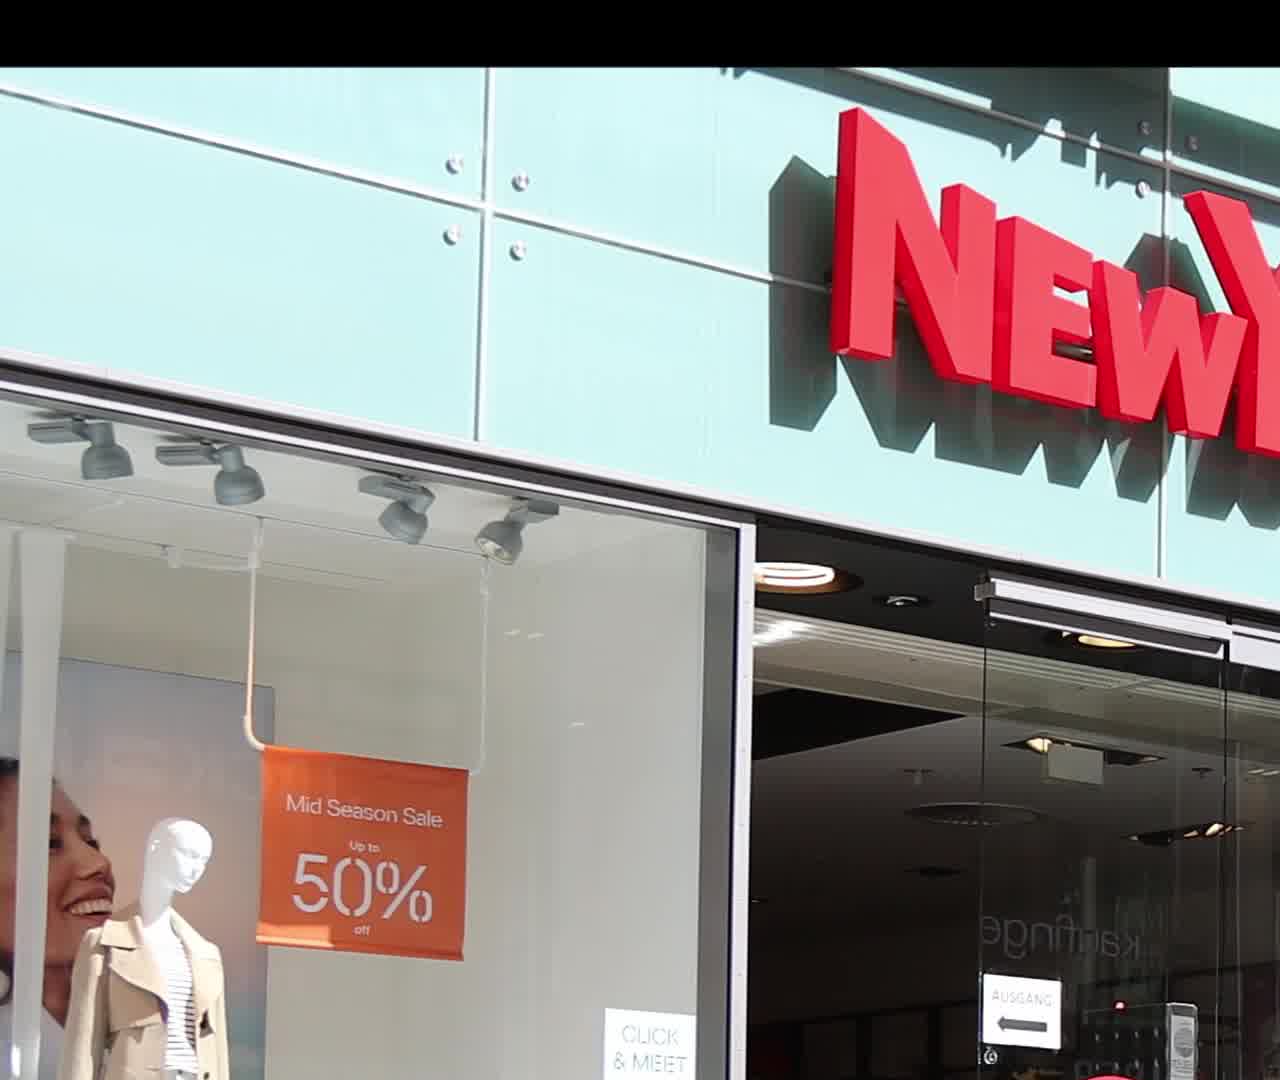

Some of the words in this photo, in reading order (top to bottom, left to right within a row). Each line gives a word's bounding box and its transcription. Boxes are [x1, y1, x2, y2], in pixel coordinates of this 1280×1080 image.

[286, 795, 322, 815] Mid
[327, 799, 398, 823] Season
[403, 808, 443, 828] Sale
[292, 853, 433, 923] 50%
[621, 1024, 680, 1046] CLICK
[613, 1050, 625, 1071] &
[632, 1052, 688, 1073] MEET
